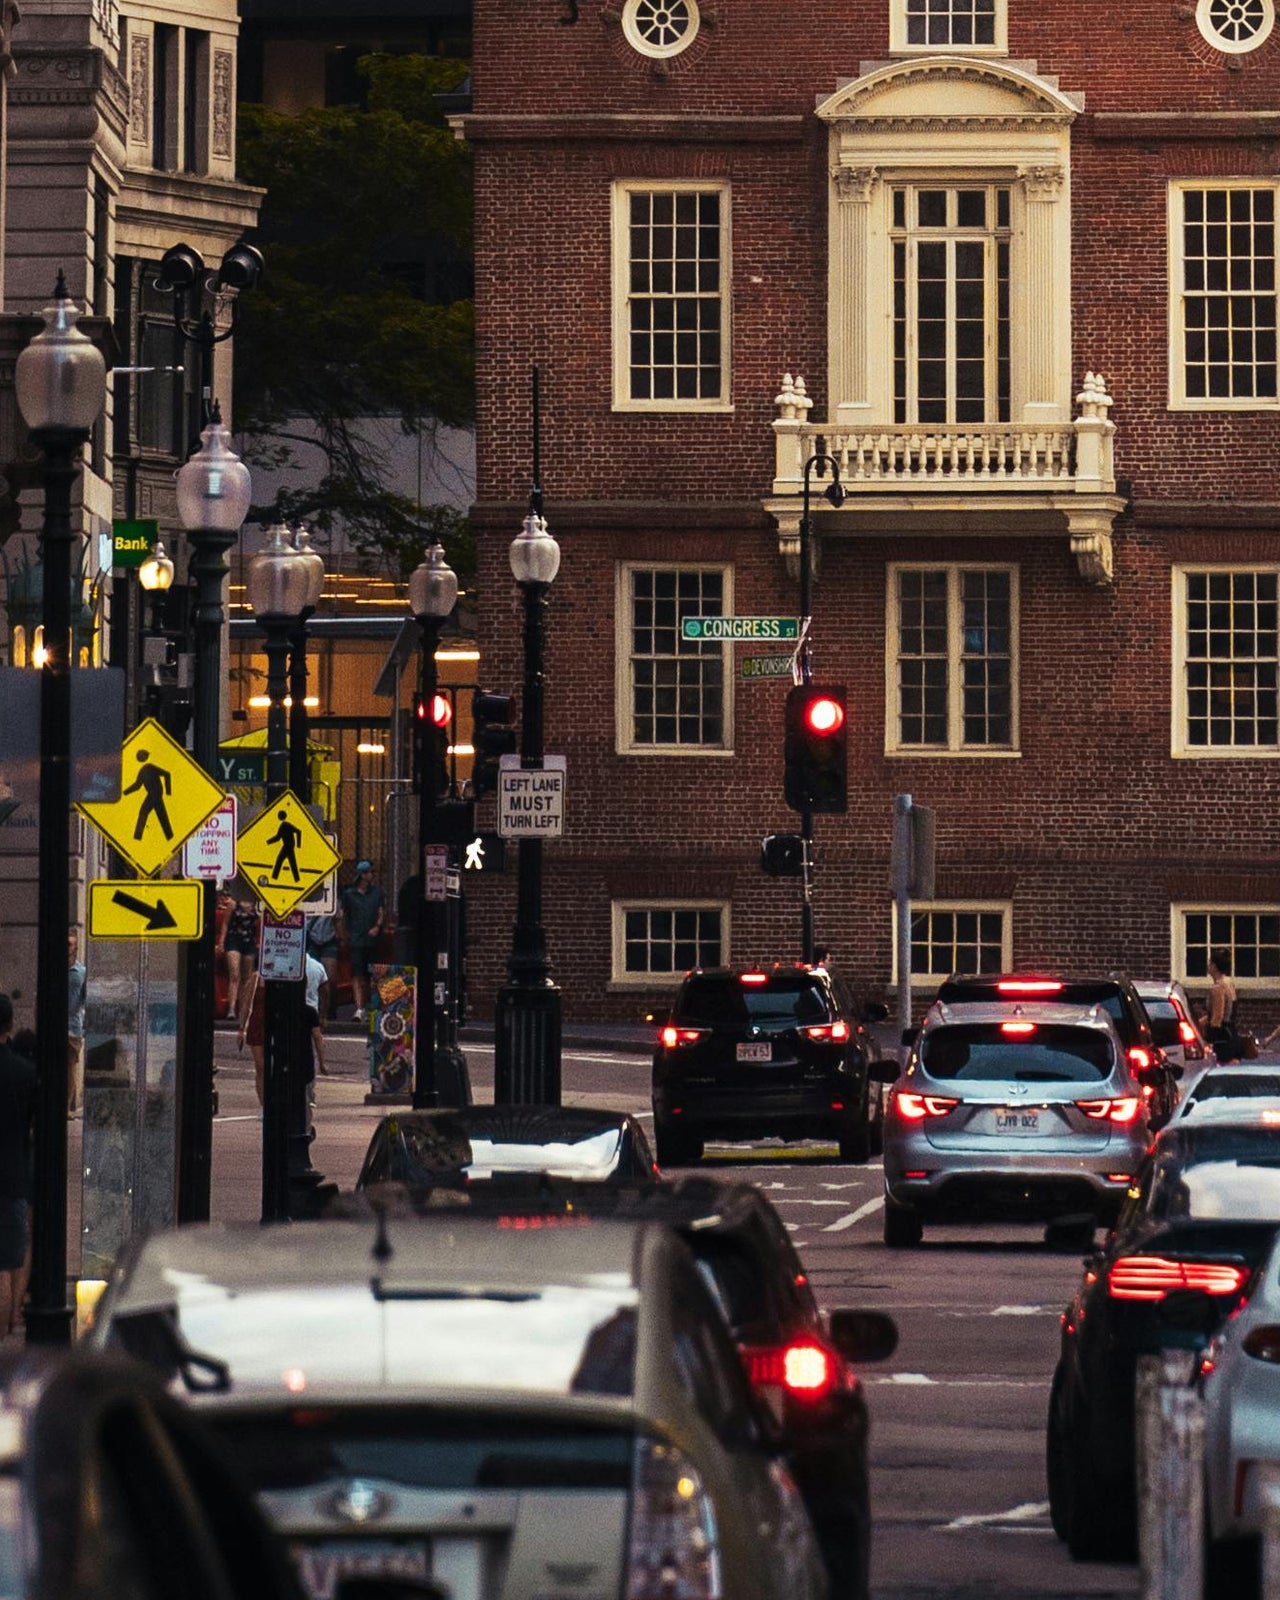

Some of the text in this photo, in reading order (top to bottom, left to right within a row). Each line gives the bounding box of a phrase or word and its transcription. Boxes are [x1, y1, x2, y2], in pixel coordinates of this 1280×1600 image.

[115, 536, 148, 550] Bank
[703, 620, 780, 637] CONGRESS
[504, 779, 560, 791] LEFT LANE
[510, 796, 548, 811] MUST
[504, 816, 560, 828] TURN LEFT
[200, 847, 219, 856] TIME
[275, 930, 291, 939] NO
